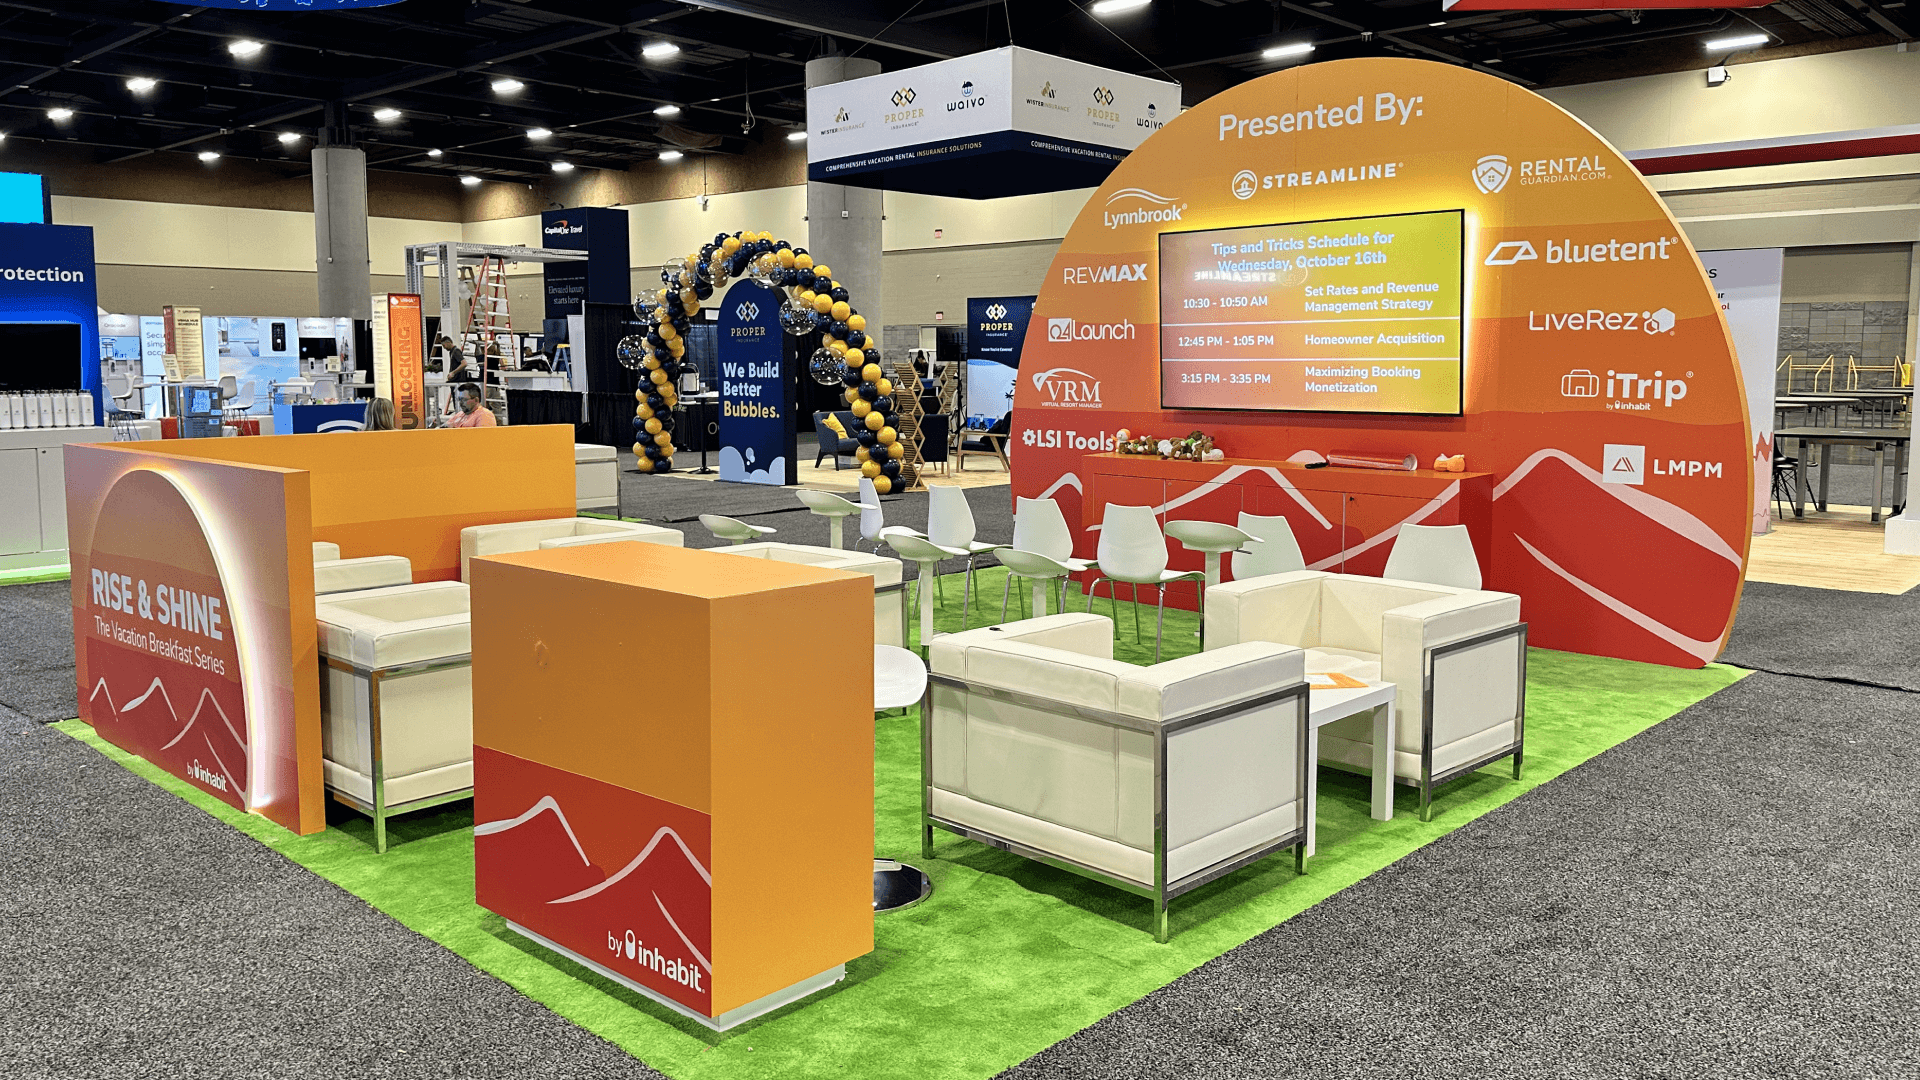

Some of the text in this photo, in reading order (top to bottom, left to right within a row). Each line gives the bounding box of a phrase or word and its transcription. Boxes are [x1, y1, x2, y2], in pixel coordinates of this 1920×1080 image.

[947, 97, 985, 112] waivo
[884, 108, 925, 124] PROPER
[1087, 107, 1120, 122] PROPER
[1219, 92, 1423, 141] Presented By:
[891, 122, 918, 130] INSURANCE
[825, 141, 982, 173] COMPREHENSIVE VACATION RENTAL INSURANCE SOLUTIONS
[1030, 140, 1071, 153] COMPREHENSIVE
[1071, 146, 1095, 157] VACATION
[1095, 151, 1112, 160] RENTAL
[1520, 155, 1606, 176] RENTAL
[1520, 171, 1606, 186] GUARDIAN.COM
[570, 225, 583, 233] Travel
[1212, 232, 1394, 256] Tips and Tricks Schedule for
[1218, 251, 1386, 272] Wednesday, October 16th
[1064, 263, 1148, 285] REVMAX
[1305, 282, 1439, 296] Set Rates and Revenue
[1183, 298, 1210, 309] 10:30
[1220, 297, 1248, 307] 10:50
[1250, 296, 1268, 306] AM
[1305, 299, 1433, 313] Management Strategy
[731, 327, 765, 336] PROPER
[980, 323, 1013, 331] PROPER
[1178, 336, 1204, 347] 12:45
[1207, 336, 1222, 346] PM
[1233, 336, 1254, 346] 1:05
[1258, 335, 1274, 346] PM
[1305, 333, 1444, 345] Homeowner Acquisition
[723, 361, 779, 378] We Build
[1305, 366, 1420, 378] Maximizing Booking
[397, 327, 418, 429] UNLOCKING
[1182, 374, 1202, 384] 3:15
[1205, 374, 1220, 384] PM
[1230, 374, 1252, 384] 3:35
[1255, 374, 1270, 384] PM
[723, 381, 762, 397] Better
[1046, 380, 1102, 402] VRM
[1305, 382, 1378, 392] Monetization
[724, 400, 780, 418] Bubbles.
[1606, 401, 1651, 411] by inhabit
[1037, 429, 1115, 452] LSI Tools
[1654, 459, 1723, 478] LMPM
[91, 568, 223, 641] RISE & SHINE
[94, 615, 225, 675] The Vacation Breakfast Series
[187, 762, 228, 792] by inhabit
[608, 930, 702, 992] by inhabit
